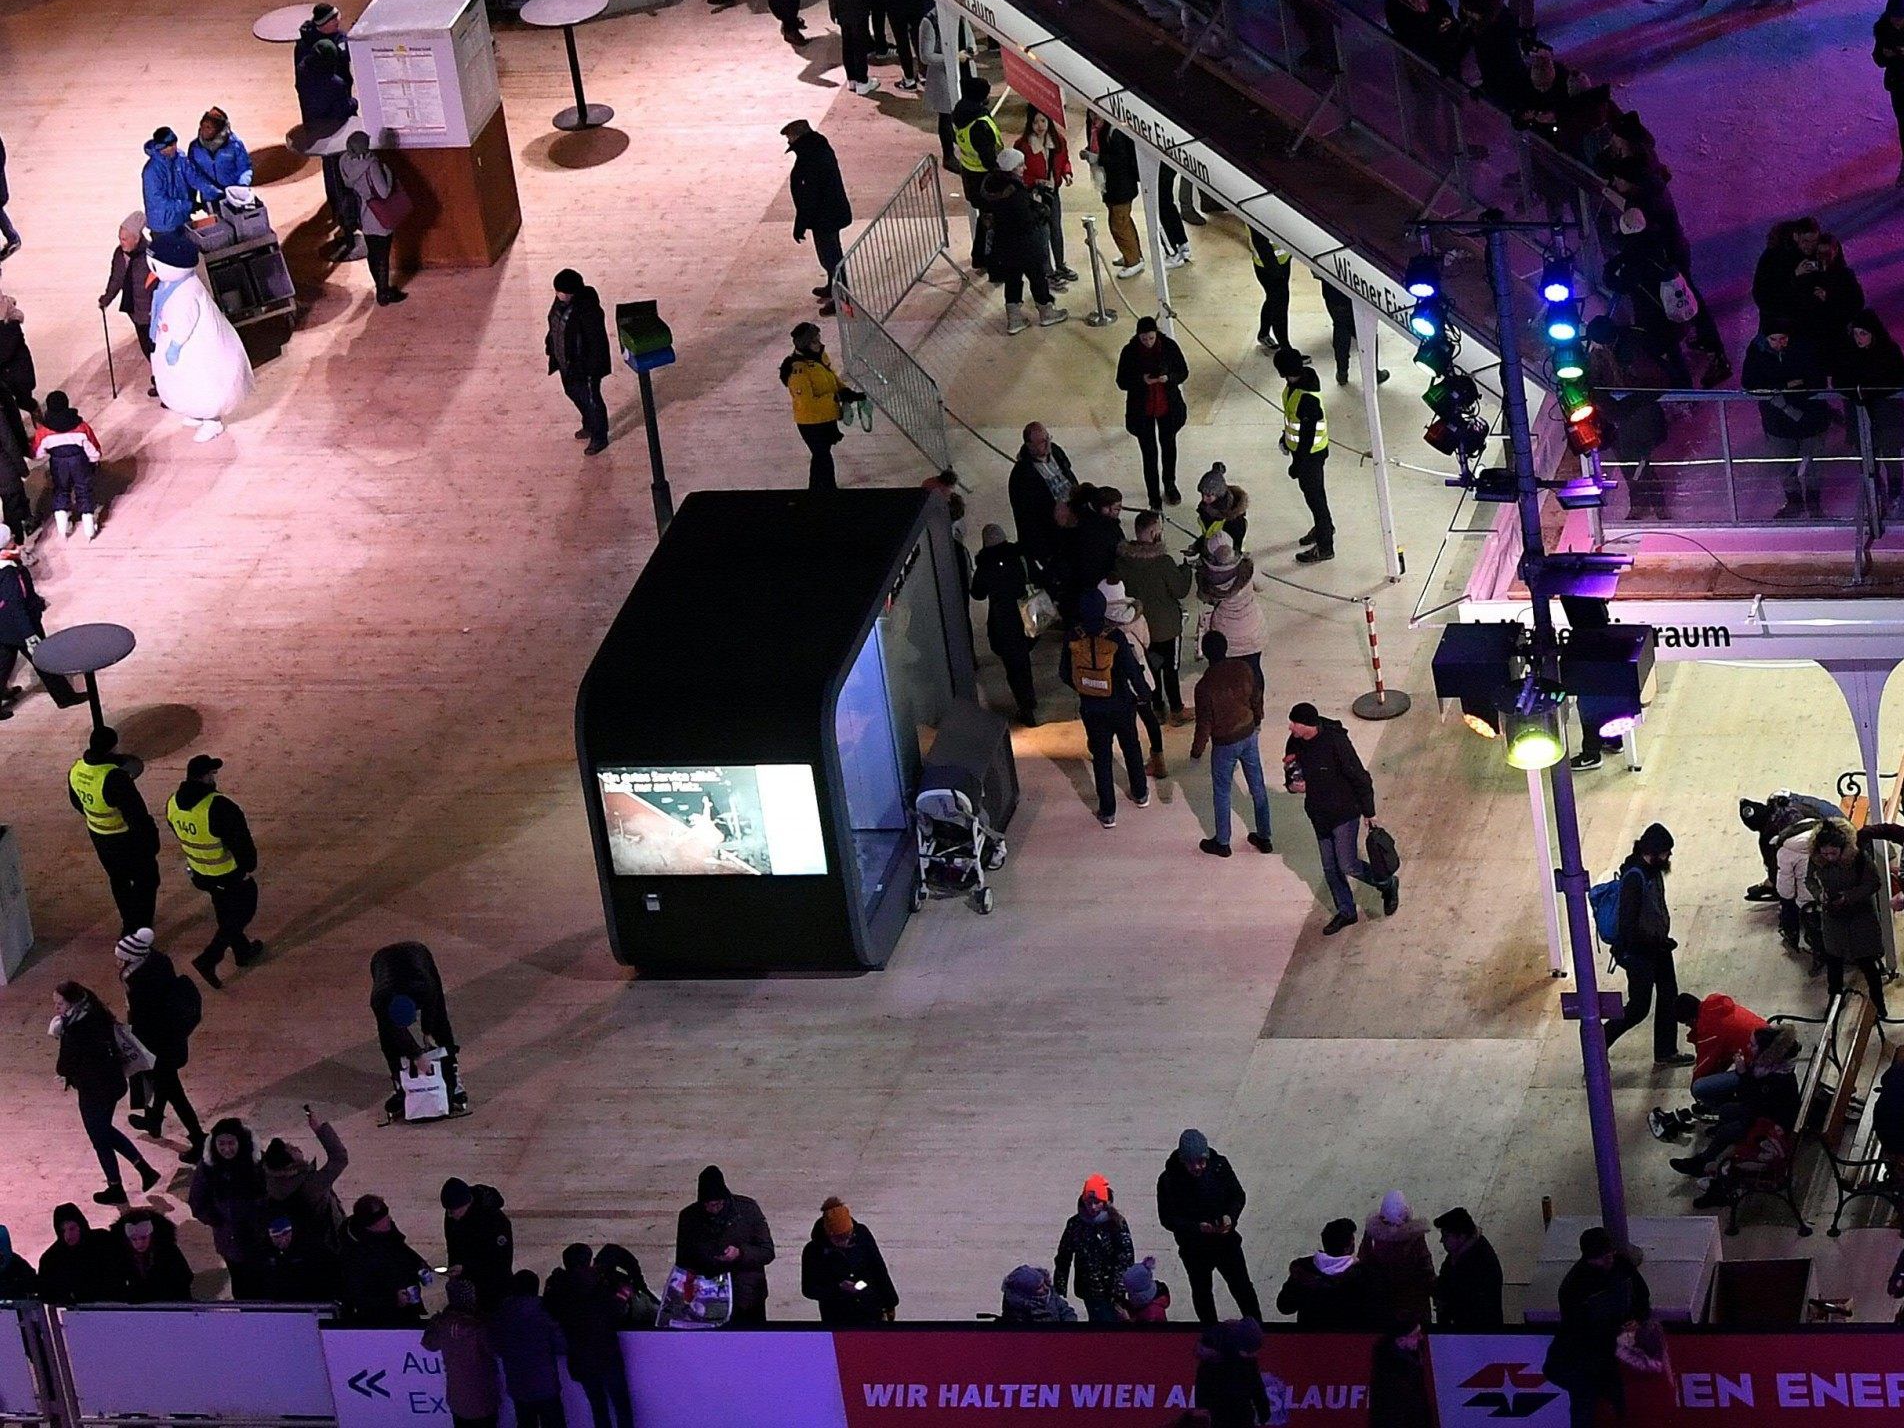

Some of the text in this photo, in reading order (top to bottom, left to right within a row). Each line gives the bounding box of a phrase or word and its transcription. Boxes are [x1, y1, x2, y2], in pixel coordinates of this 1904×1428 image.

[1107, 87, 1210, 184] Wiener Eistraum
[1333, 254, 1382, 307] Wiener
[176, 820, 197, 835] 140
[863, 1384, 928, 1408] WIR
[938, 1384, 1060, 1408] HALTEN
[1070, 1384, 1156, 1408] WIEN
